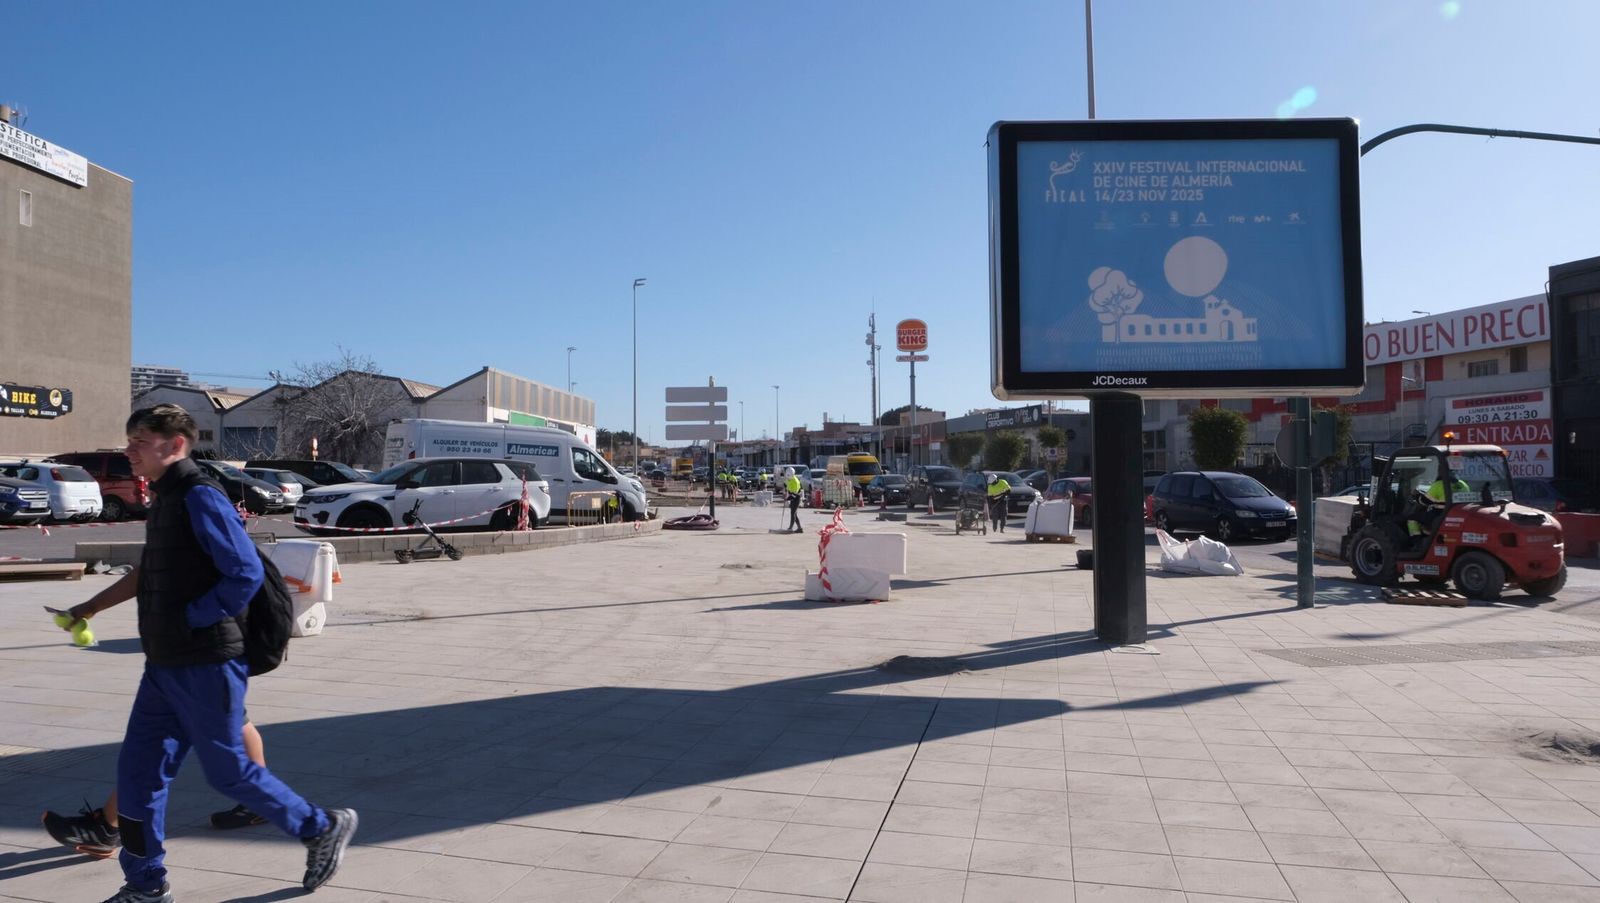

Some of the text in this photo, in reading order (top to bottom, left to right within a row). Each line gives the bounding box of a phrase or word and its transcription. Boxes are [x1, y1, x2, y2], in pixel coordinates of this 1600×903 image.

[1093, 160, 1306, 173] XXIV FESTIVAL INTERNACIONAL
[1093, 172, 1233, 188] DE CINE DE ALMERÍA
[1095, 189, 1204, 202] 14/23 NOV 2025
[1388, 321, 1455, 358] BUEN
[1463, 302, 1546, 347] PRECI
[897, 336, 927, 344] KING
[1092, 375, 1148, 386] JCDecaux
[11, 391, 37, 404] BIKE
[1464, 394, 1529, 407] HORARIO
[1458, 410, 1538, 424] 09:30 A 21:30
[1467, 424, 1552, 444] ENTRADA
[509, 444, 558, 456] Almericar
